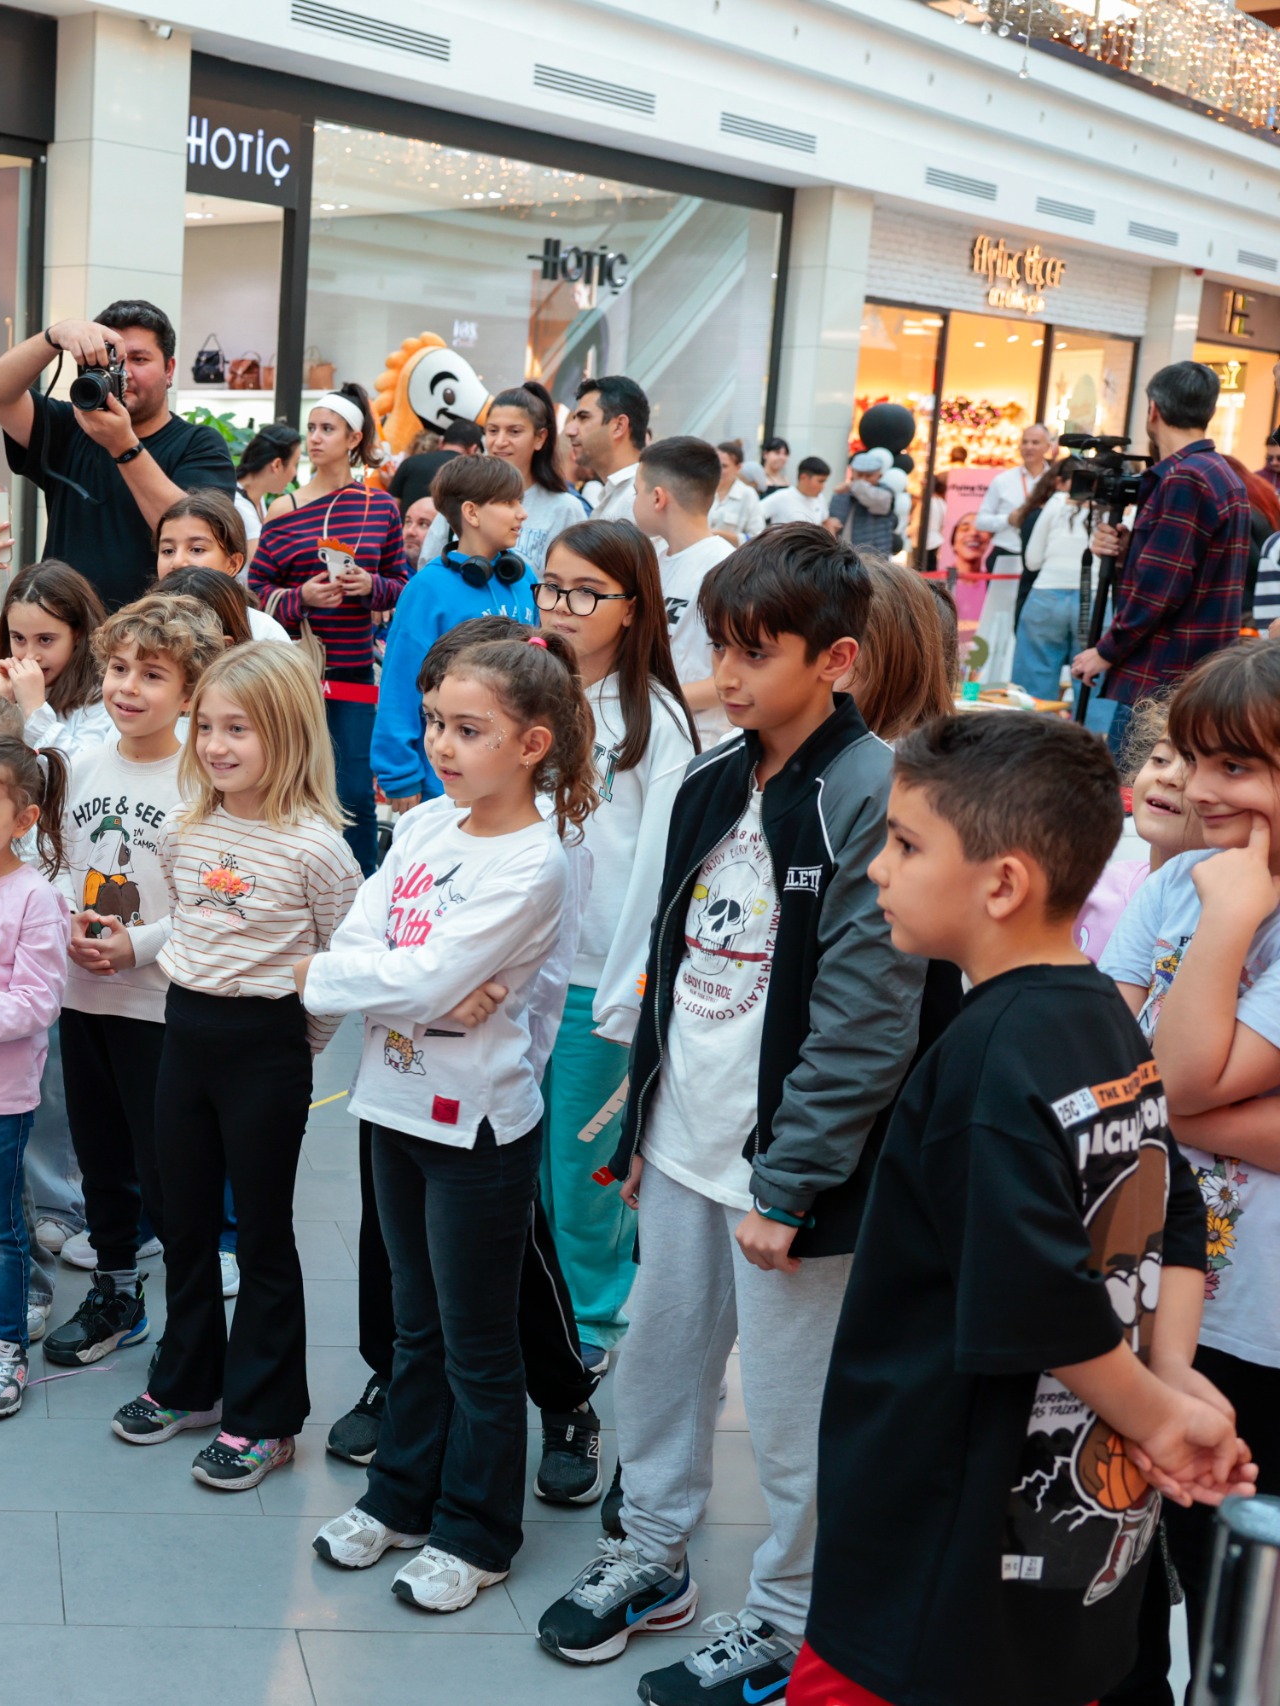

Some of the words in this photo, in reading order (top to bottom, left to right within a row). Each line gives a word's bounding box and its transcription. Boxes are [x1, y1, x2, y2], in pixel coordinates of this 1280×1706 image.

[186, 115, 291, 187] HOTİÇ
[72, 796, 111, 828] HIDE
[115, 795, 129, 814] &
[135, 802, 166, 829] SEE
[133, 828, 144, 837] IN
[391, 862, 434, 904] ello
[703, 980, 714, 995] TO
